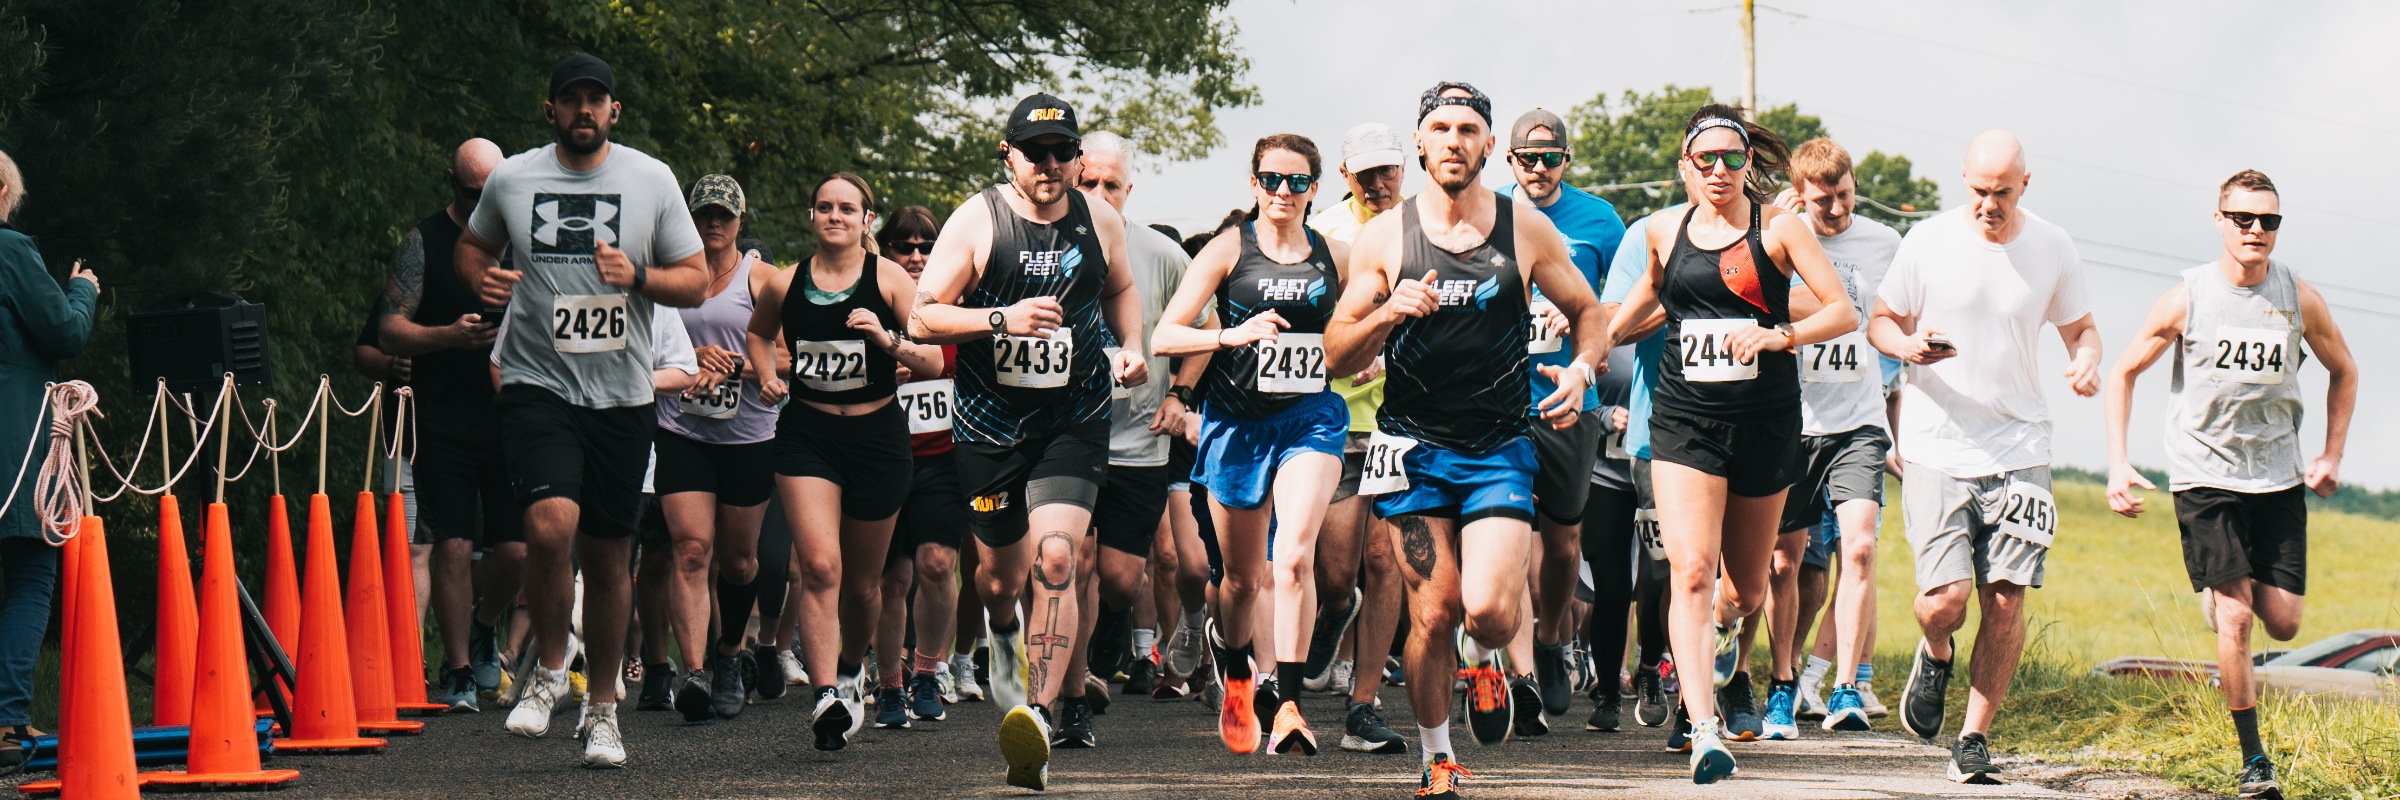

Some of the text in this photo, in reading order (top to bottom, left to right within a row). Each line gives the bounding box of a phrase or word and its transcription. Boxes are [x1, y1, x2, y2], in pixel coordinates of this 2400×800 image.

[531, 255, 595, 265] UNDER ARM
[1019, 250, 1062, 264] FLEET
[1024, 263, 1059, 276] FEET
[1258, 278, 1308, 290] FLEET
[1263, 288, 1305, 301] FEET
[1431, 279, 1477, 293] LEET
[1438, 292, 1472, 306] EET
[555, 306, 625, 340] 2426
[995, 339, 1069, 374] 2433
[1260, 346, 1324, 379] 2432
[1682, 333, 1755, 367] 244
[1812, 344, 1858, 371] 744
[2216, 339, 2283, 373] 2434
[798, 351, 865, 382] 2422
[901, 390, 948, 421] 756
[2005, 493, 2055, 536] 2451
